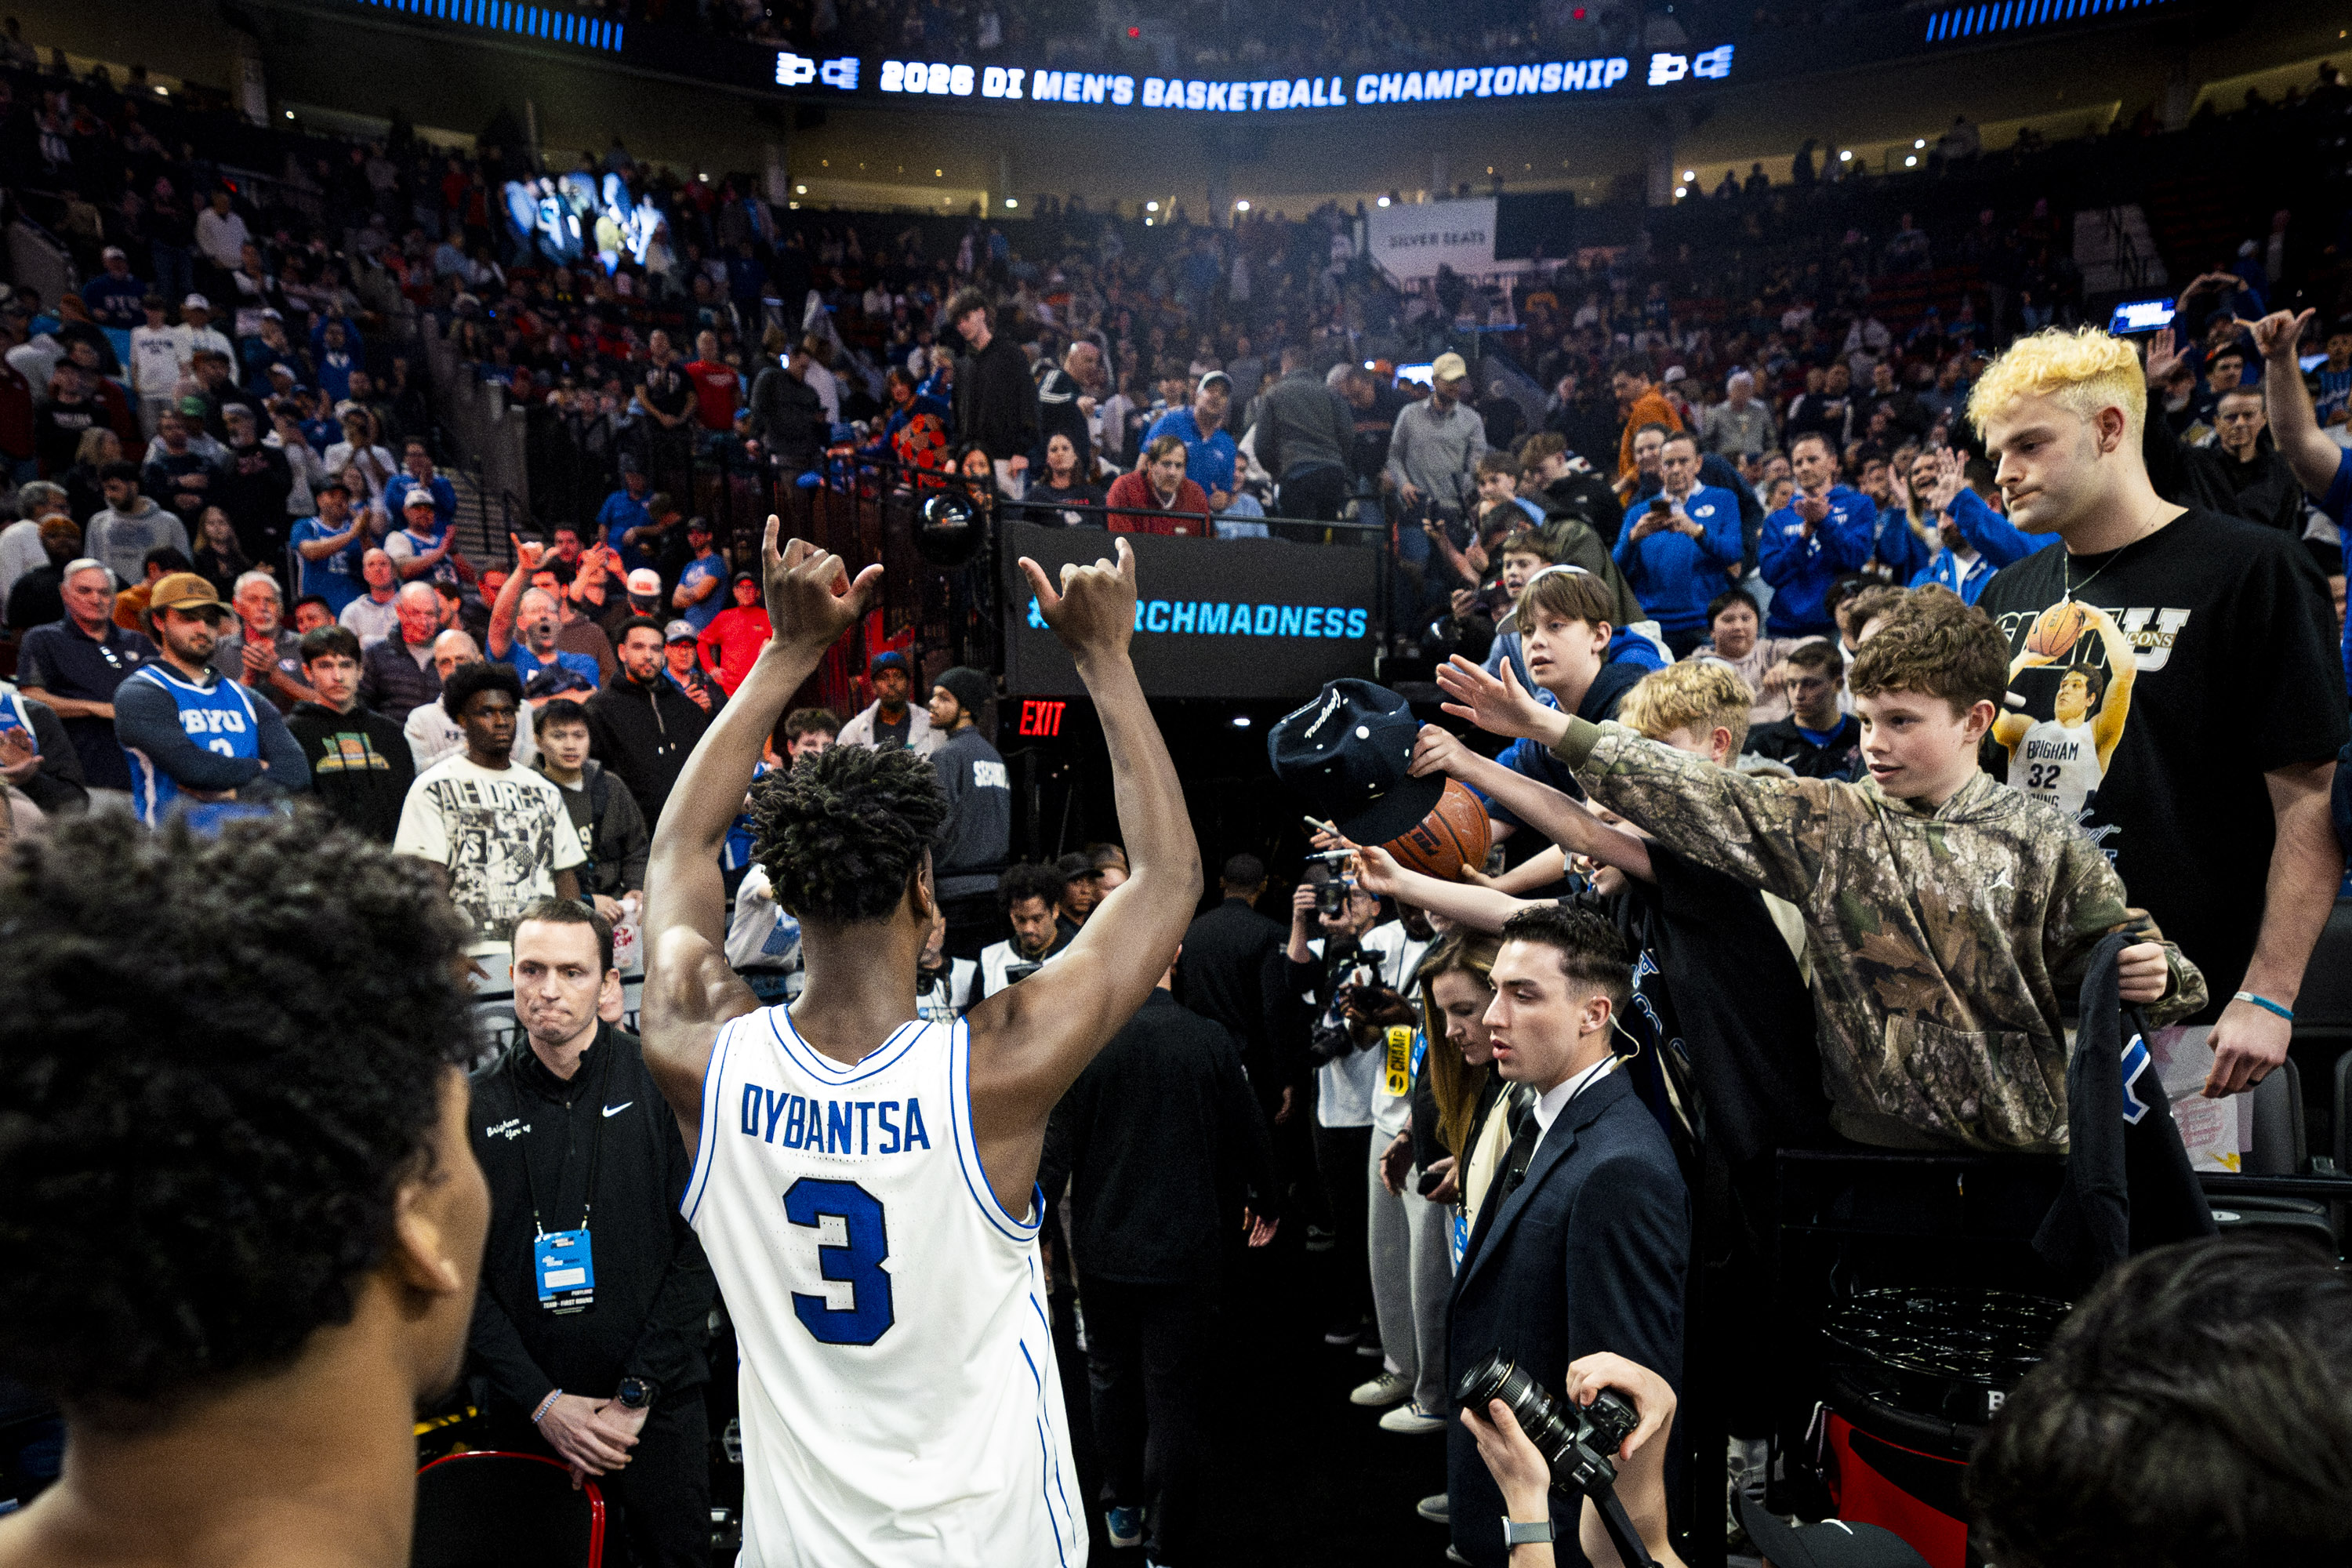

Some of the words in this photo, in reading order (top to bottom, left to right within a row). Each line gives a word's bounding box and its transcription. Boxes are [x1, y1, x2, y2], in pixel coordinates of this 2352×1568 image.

[880, 60, 975, 96] 2026
[982, 67, 1025, 99] DI
[1031, 69, 1134, 106] MEN'S
[1142, 76, 1347, 111] BASKETBALL
[1356, 57, 1628, 103] CHAMPIONSHIP
[180, 708, 246, 734] BYU
[1019, 700, 1066, 736] EXIT
[2027, 739, 2079, 761] BRIGHAM
[2027, 764, 2061, 789] 32
[486, 1118, 519, 1138] Brigham
[741, 1083, 931, 1155] DYBANTSA
[782, 1176, 895, 1346] 3
